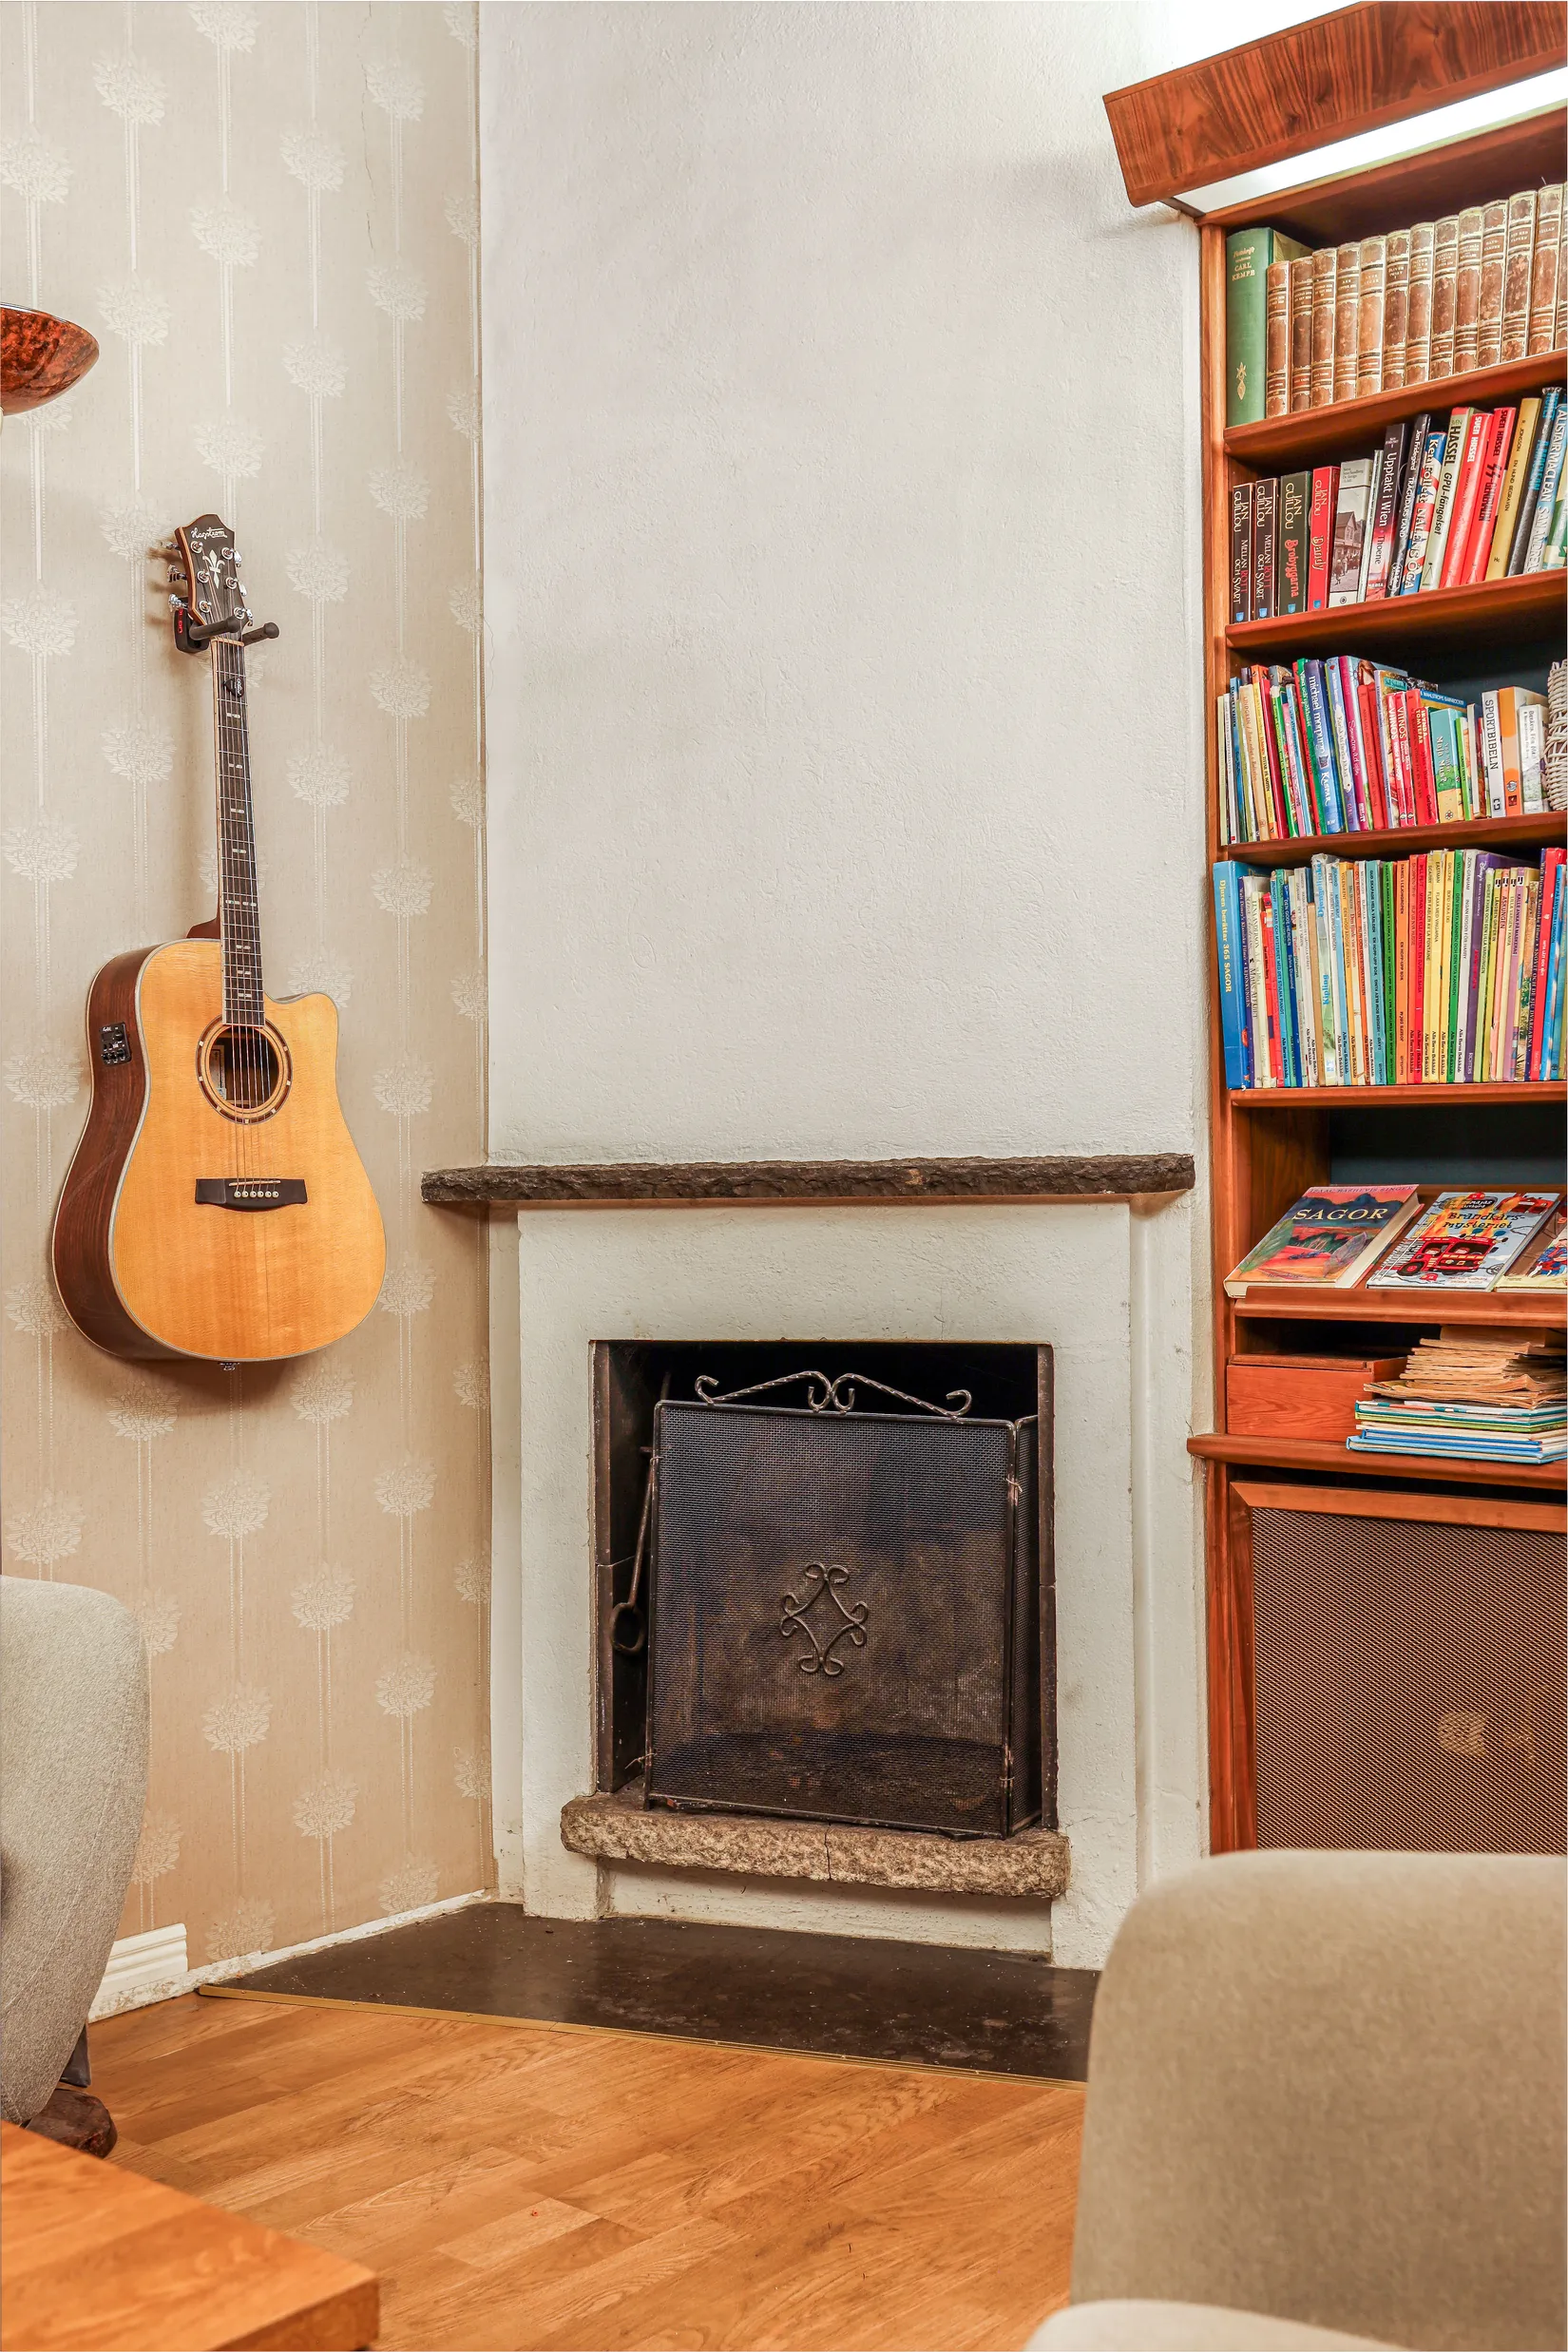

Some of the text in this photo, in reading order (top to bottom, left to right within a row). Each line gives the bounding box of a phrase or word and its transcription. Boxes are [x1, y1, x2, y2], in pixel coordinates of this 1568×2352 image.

[1472, 416, 1482, 434] SVEN
[1499, 410, 1509, 429] SVEN
[1551, 410, 1566, 450] ALISTAIR
[1410, 441, 1421, 470] Fridegård
[1426, 439, 1439, 464] Ken
[1466, 437, 1478, 463] HASSEL
[1493, 431, 1504, 456] HASSEL
[1382, 451, 1397, 492] Upptakt
[1434, 427, 1461, 535] HASSEL GPU-fängelset
[1541, 452, 1559, 502] MACLEAN
[1256, 487, 1265, 526] GUILLOU
[1285, 483, 1294, 528] GUILLOU
[1293, 495, 1302, 515] JAN
[1313, 480, 1322, 515] GUILLOU
[1504, 486, 1515, 511] BEGRAVEN
[1379, 502, 1391, 526] Wien
[1399, 519, 1407, 537] LAND
[1311, 536, 1327, 570] Dandy
[1375, 536, 1386, 564] Thoene
[1285, 540, 1299, 597] Brobyggarna
[1405, 559, 1422, 589] ÖGA
[1309, 677, 1321, 710] michael
[1321, 772, 1330, 806] KASPAR
[1436, 736, 1444, 756] Maja
[1485, 699, 1498, 770] SPORTBIBELN
[1477, 861, 1486, 882] Disney's
[1322, 975, 1330, 1004] Kipling
[1531, 987, 1536, 996] DE
[1292, 1209, 1387, 1220] SAGOR
[1447, 1213, 1525, 1221] Brandkårs-
